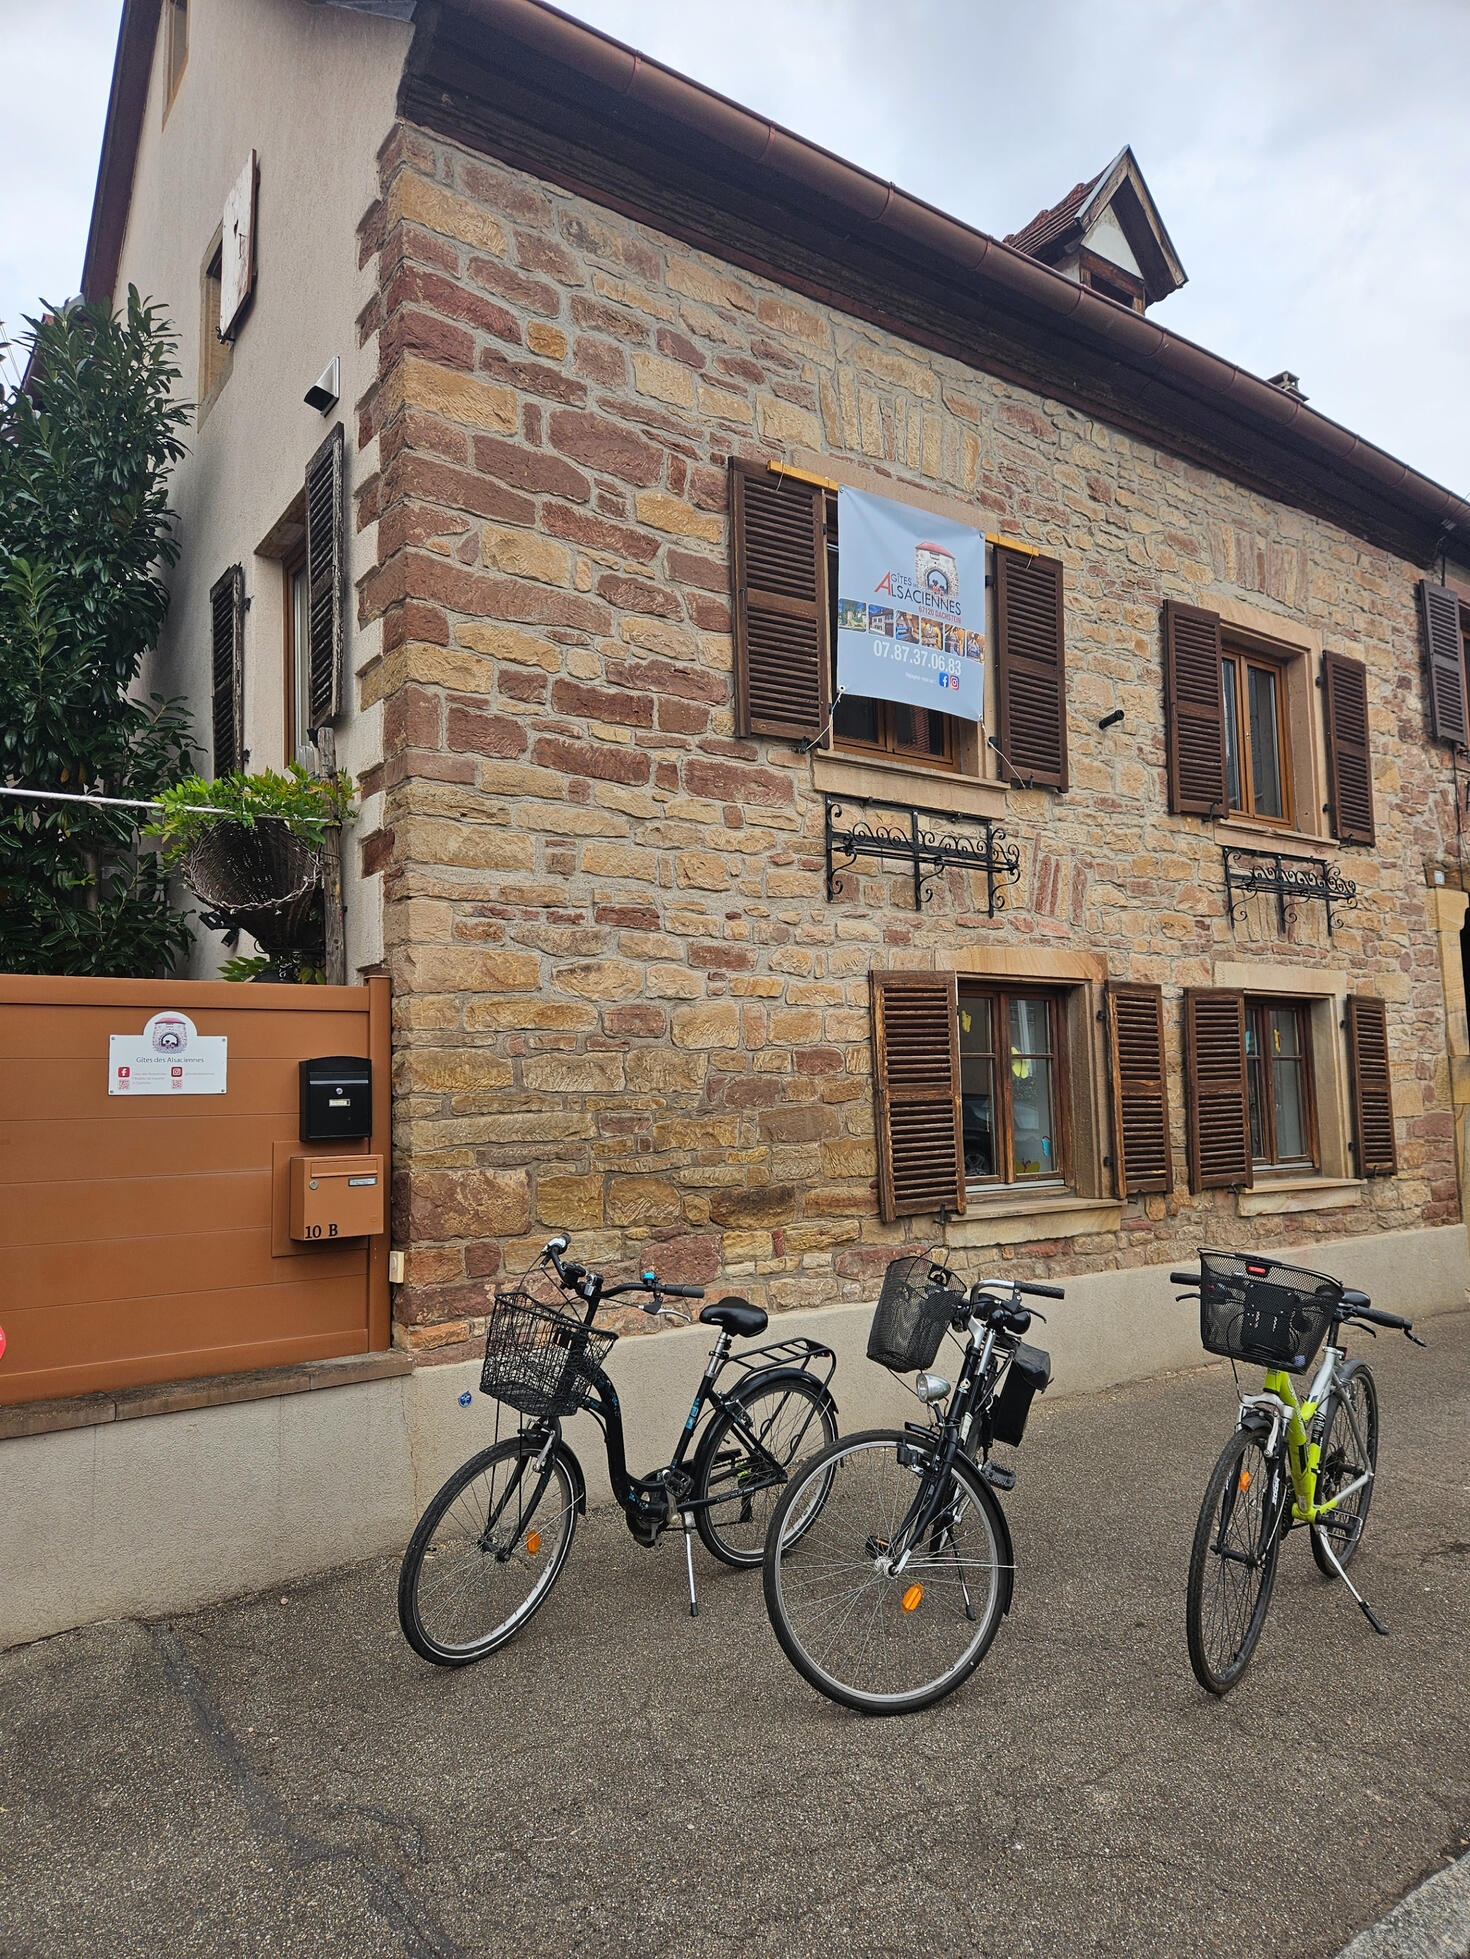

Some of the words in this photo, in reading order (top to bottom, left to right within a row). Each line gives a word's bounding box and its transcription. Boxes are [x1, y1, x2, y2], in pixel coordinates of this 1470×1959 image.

[874, 571, 961, 615] ALSACIENNES
[873, 640, 961, 675] 07.87.37.06.83
[305, 1225, 322, 1239] 10
[328, 1224, 338, 1237] B
